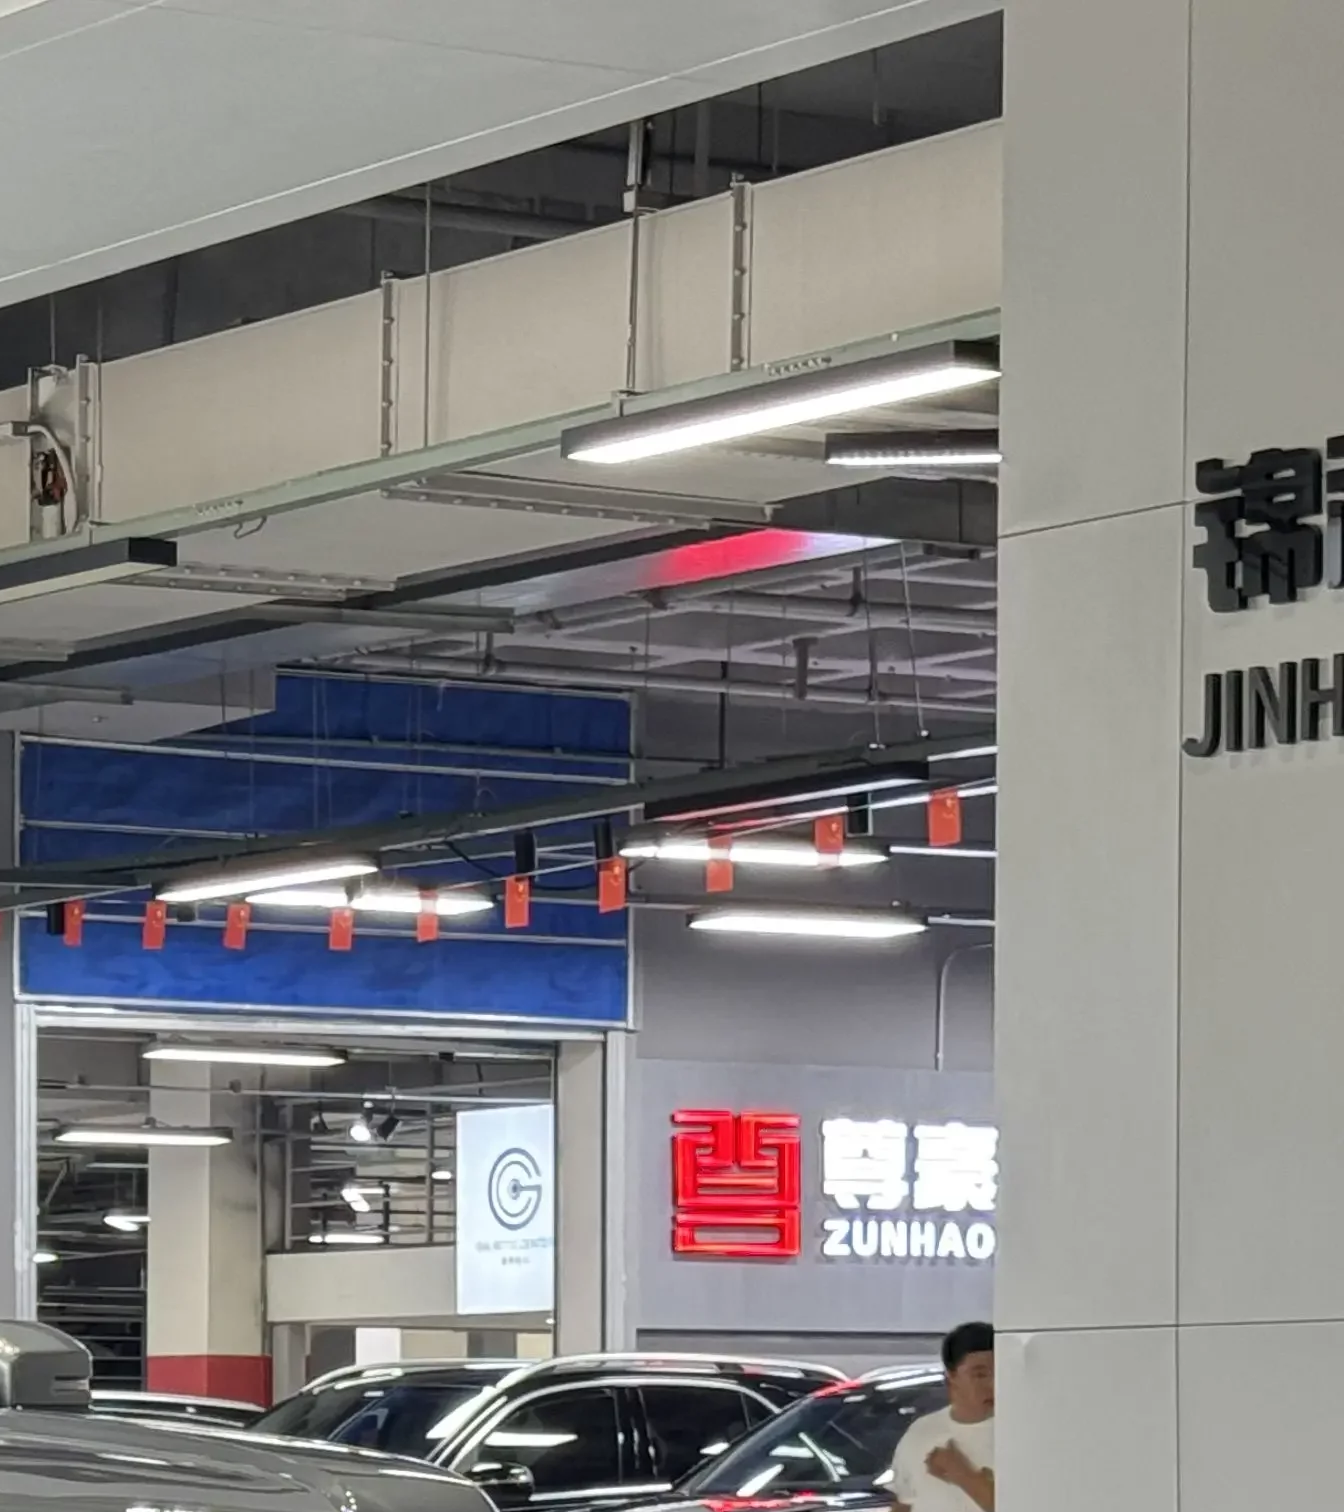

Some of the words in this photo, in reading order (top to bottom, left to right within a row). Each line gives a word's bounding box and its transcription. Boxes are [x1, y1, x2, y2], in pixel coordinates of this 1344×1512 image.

[1193, 434, 1344, 613] 锦
[1182, 653, 1344, 757] JINH
[823, 1219, 996, 1259] ZUNHAO
